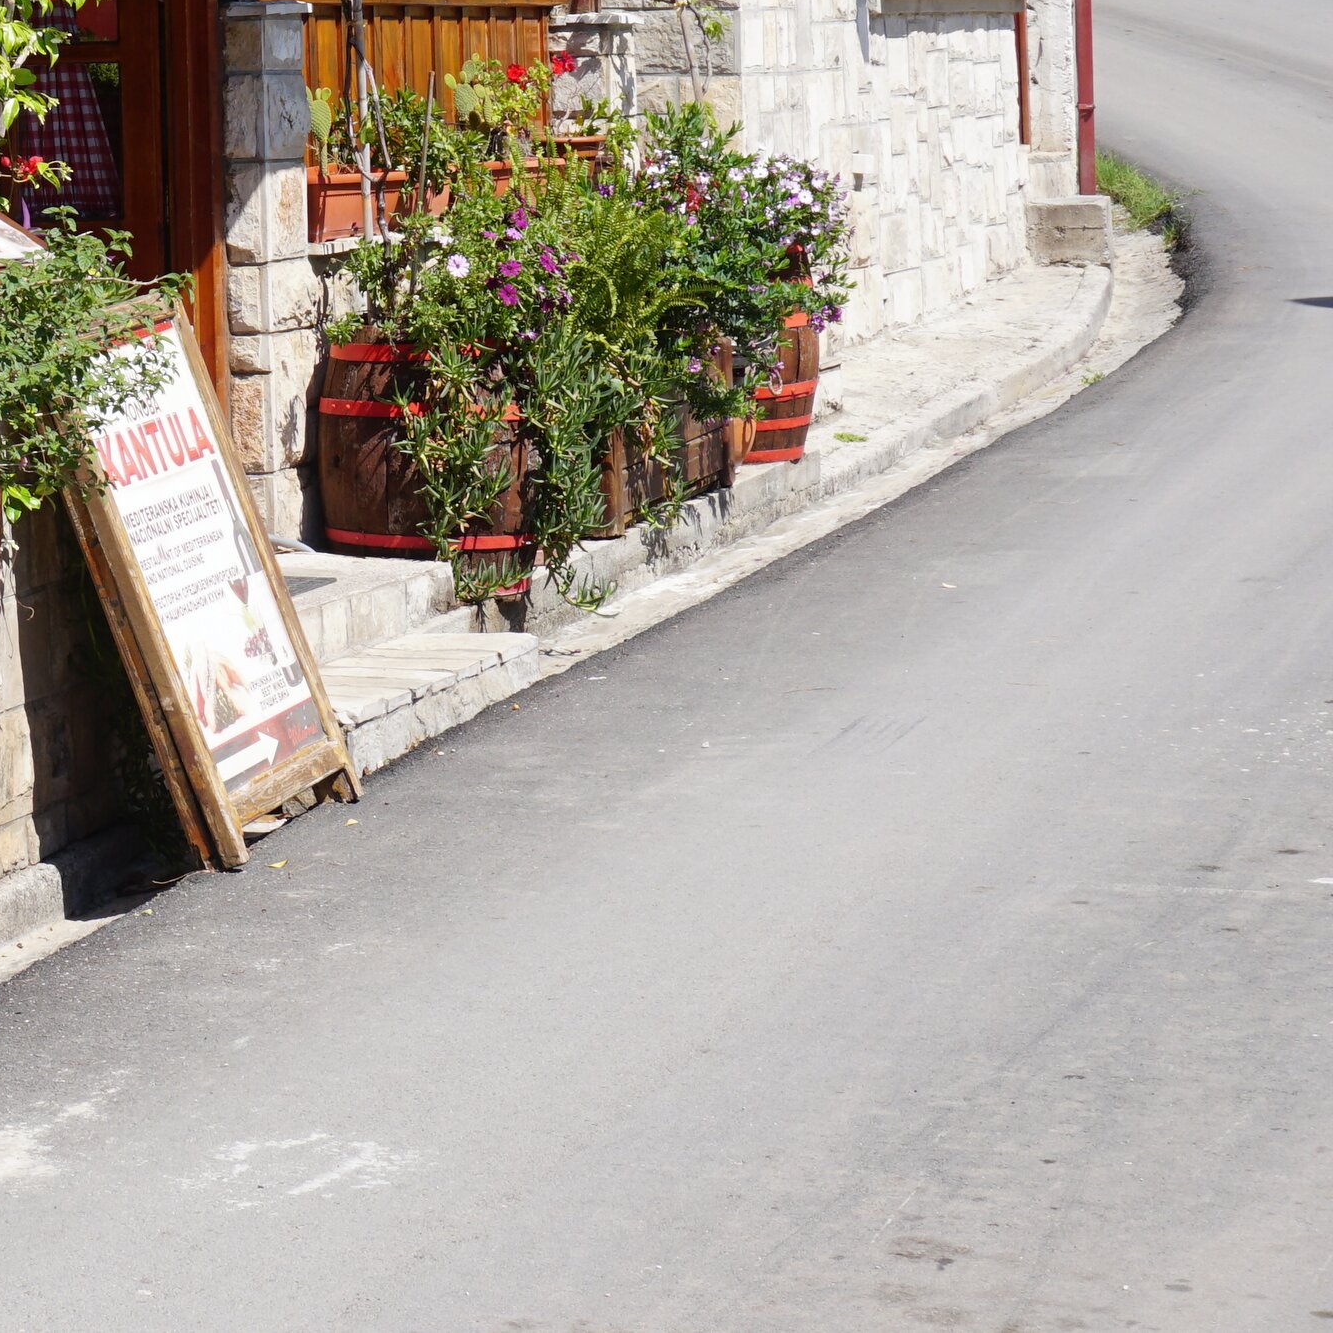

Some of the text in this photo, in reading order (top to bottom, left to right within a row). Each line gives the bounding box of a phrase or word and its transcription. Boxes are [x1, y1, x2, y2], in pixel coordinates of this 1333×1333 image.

[95, 406, 216, 488] KANTULA
[123, 497, 179, 529] MEDITERANSKA
[180, 487, 211, 512] KUHINJA
[130, 498, 224, 547] NACIONALNI SPECIJALITETI
